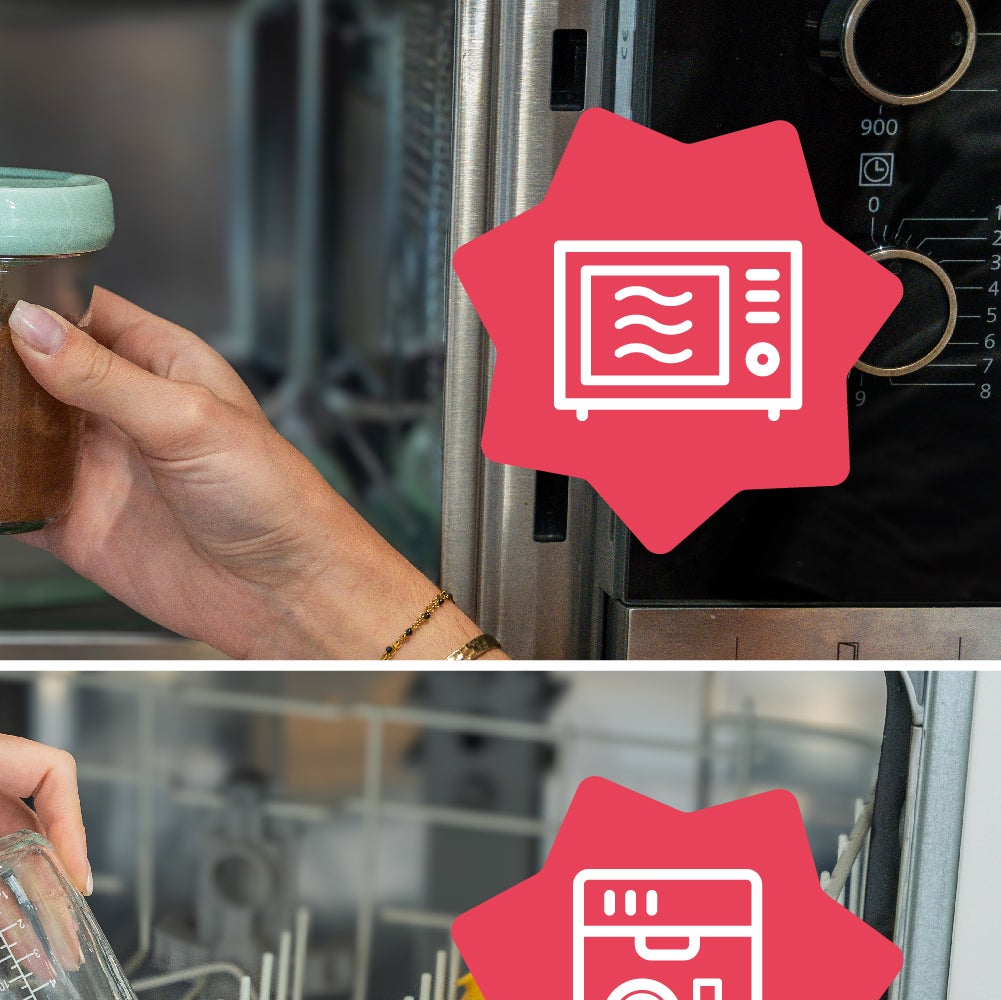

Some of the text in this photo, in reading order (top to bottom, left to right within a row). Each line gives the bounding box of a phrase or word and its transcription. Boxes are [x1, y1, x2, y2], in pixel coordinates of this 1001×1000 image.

[861, 118, 898, 136] 900
[868, 196, 880, 213] 0
[992, 230, 1001, 246] 2
[990, 255, 1001, 270] 3
[988, 280, 999, 296] 4
[986, 307, 997, 323] 5
[984, 333, 995, 349] 6
[982, 358, 994, 374] 7
[855, 390, 866, 407] 9
[979, 383, 991, 399] 8
[1, 890, 8, 900] 1
[17, 919, 25, 929] 2
[33, 948, 41, 958] 3
[49, 978, 57, 988] 4
